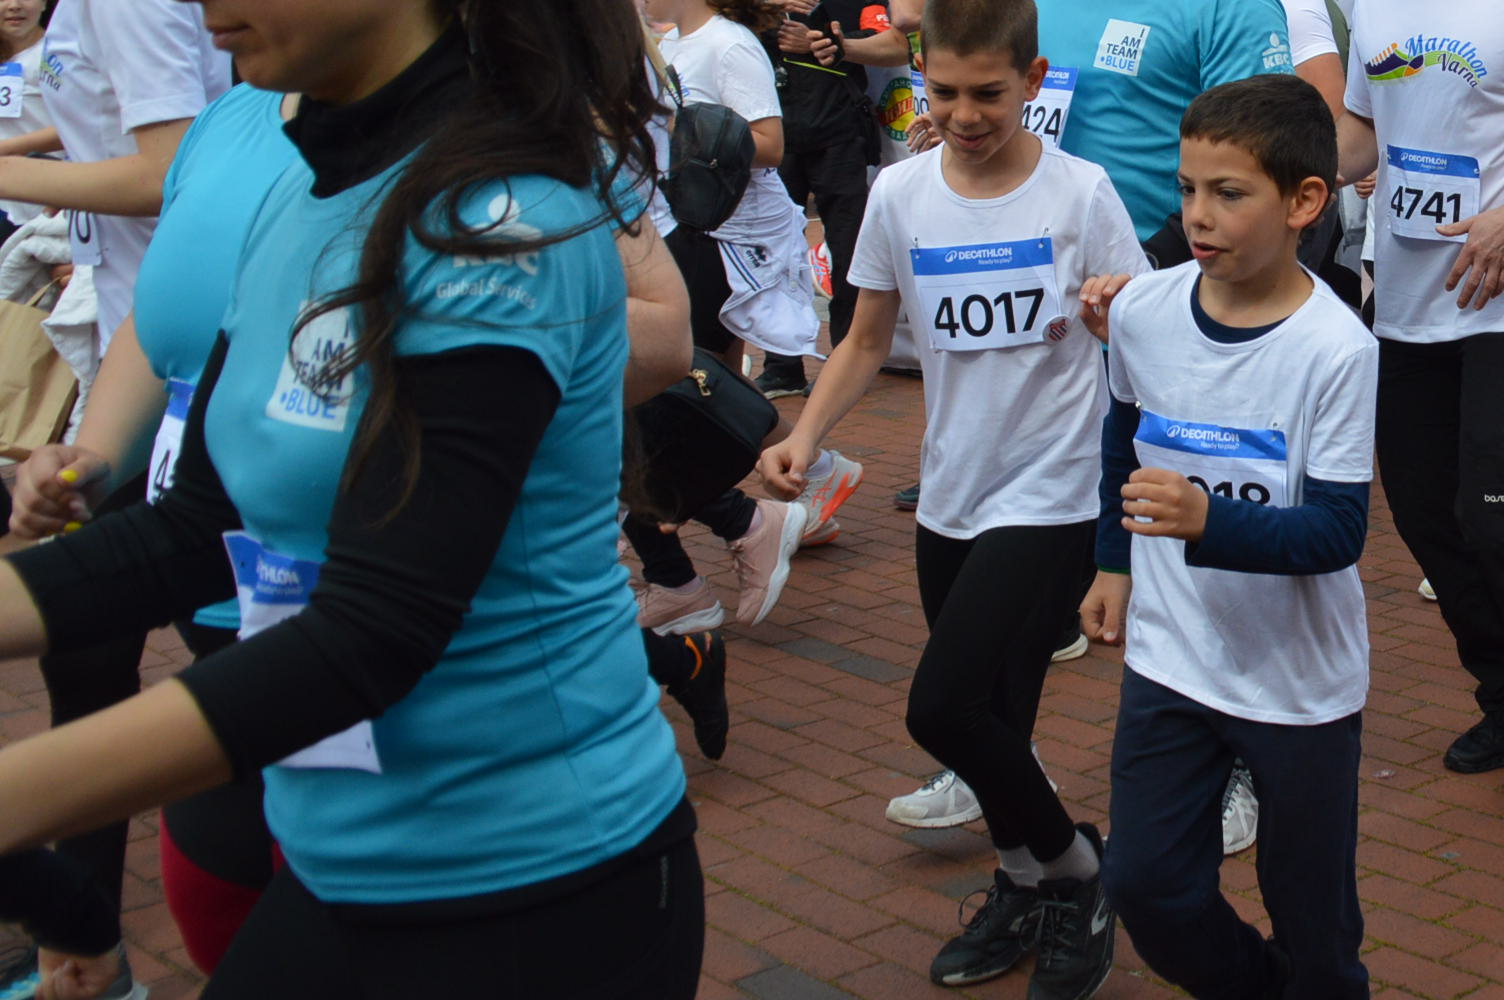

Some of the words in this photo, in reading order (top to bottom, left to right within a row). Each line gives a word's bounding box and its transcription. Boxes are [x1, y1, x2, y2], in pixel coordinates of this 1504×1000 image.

[1121, 35, 1141, 49] AM
[1106, 43, 1137, 59] TEAM
[1405, 34, 1488, 79] Marathon
[1105, 56, 1135, 72] BLUE
[1263, 53, 1291, 69] KBC
[1437, 53, 1478, 88] Varna
[1390, 185, 1461, 224] 4741
[958, 247, 1013, 261] DECATHLON
[436, 278, 484, 299] Global
[934, 287, 1045, 339] 4017
[1181, 427, 1240, 443] DECATHLON
